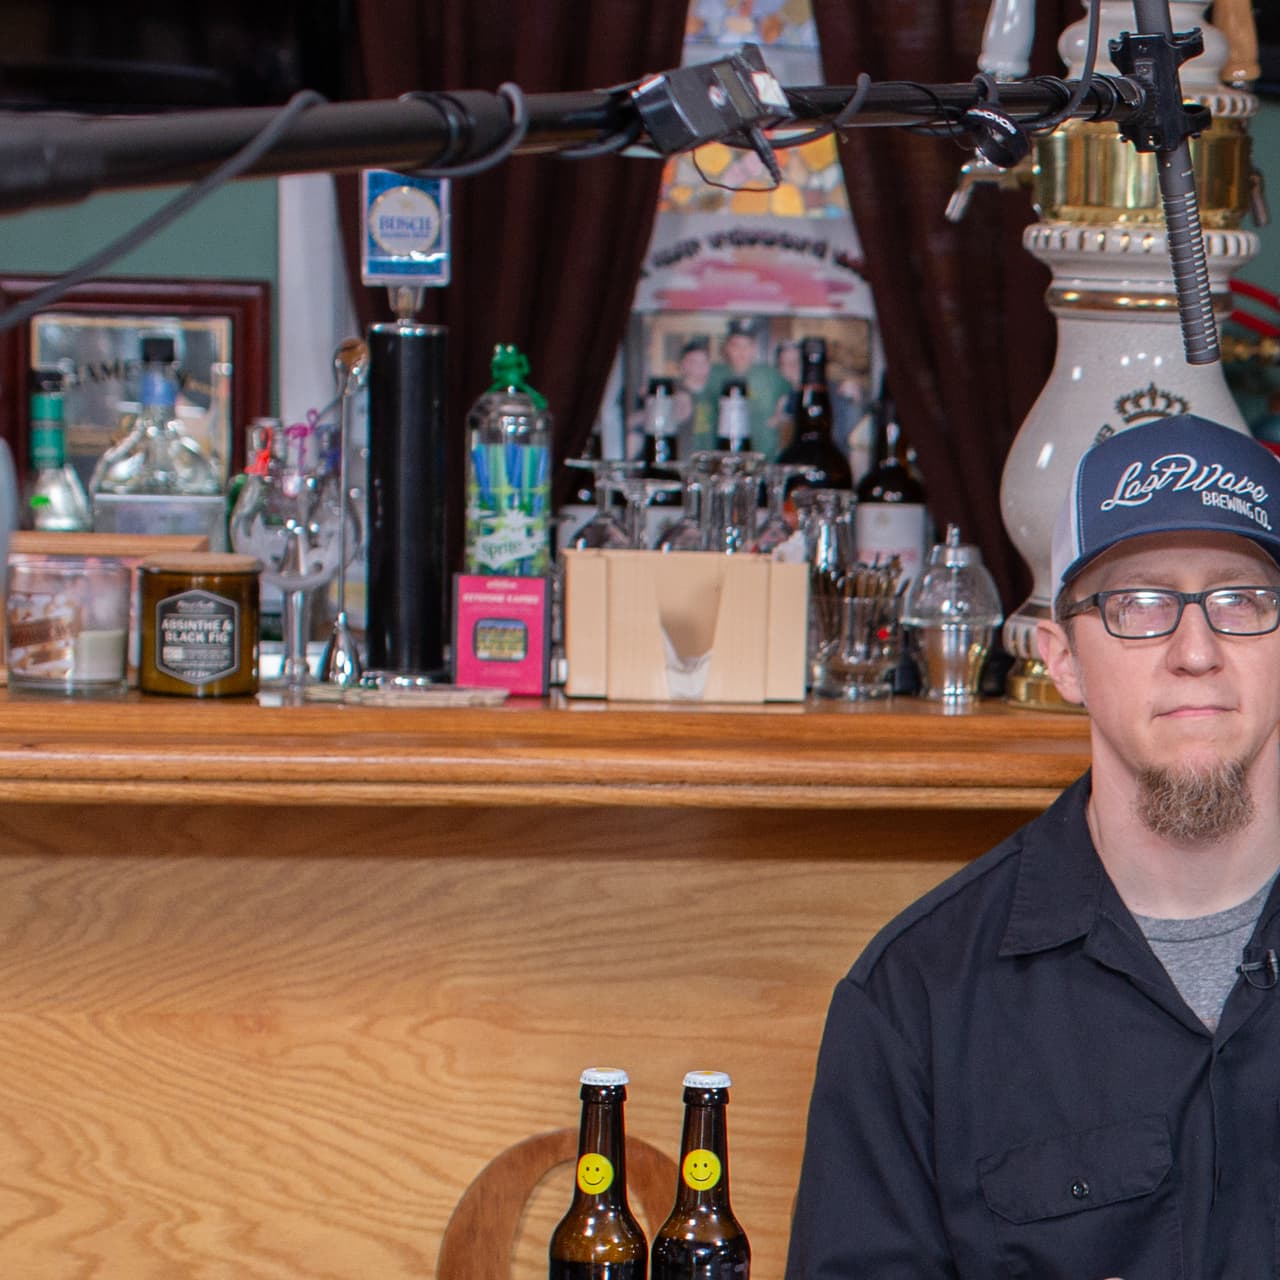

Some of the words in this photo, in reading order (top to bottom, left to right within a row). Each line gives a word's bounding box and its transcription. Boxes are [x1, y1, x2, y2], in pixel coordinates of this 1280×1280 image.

[1101, 461, 1184, 511] Last
[1151, 453, 1269, 502] Wave
[1202, 490, 1254, 521] BREWING
[1254, 508, 1273, 532] CO.
[161, 618, 220, 632] ABSINTHE
[164, 631, 205, 642] BLACK
[208, 632, 229, 643] FIG
